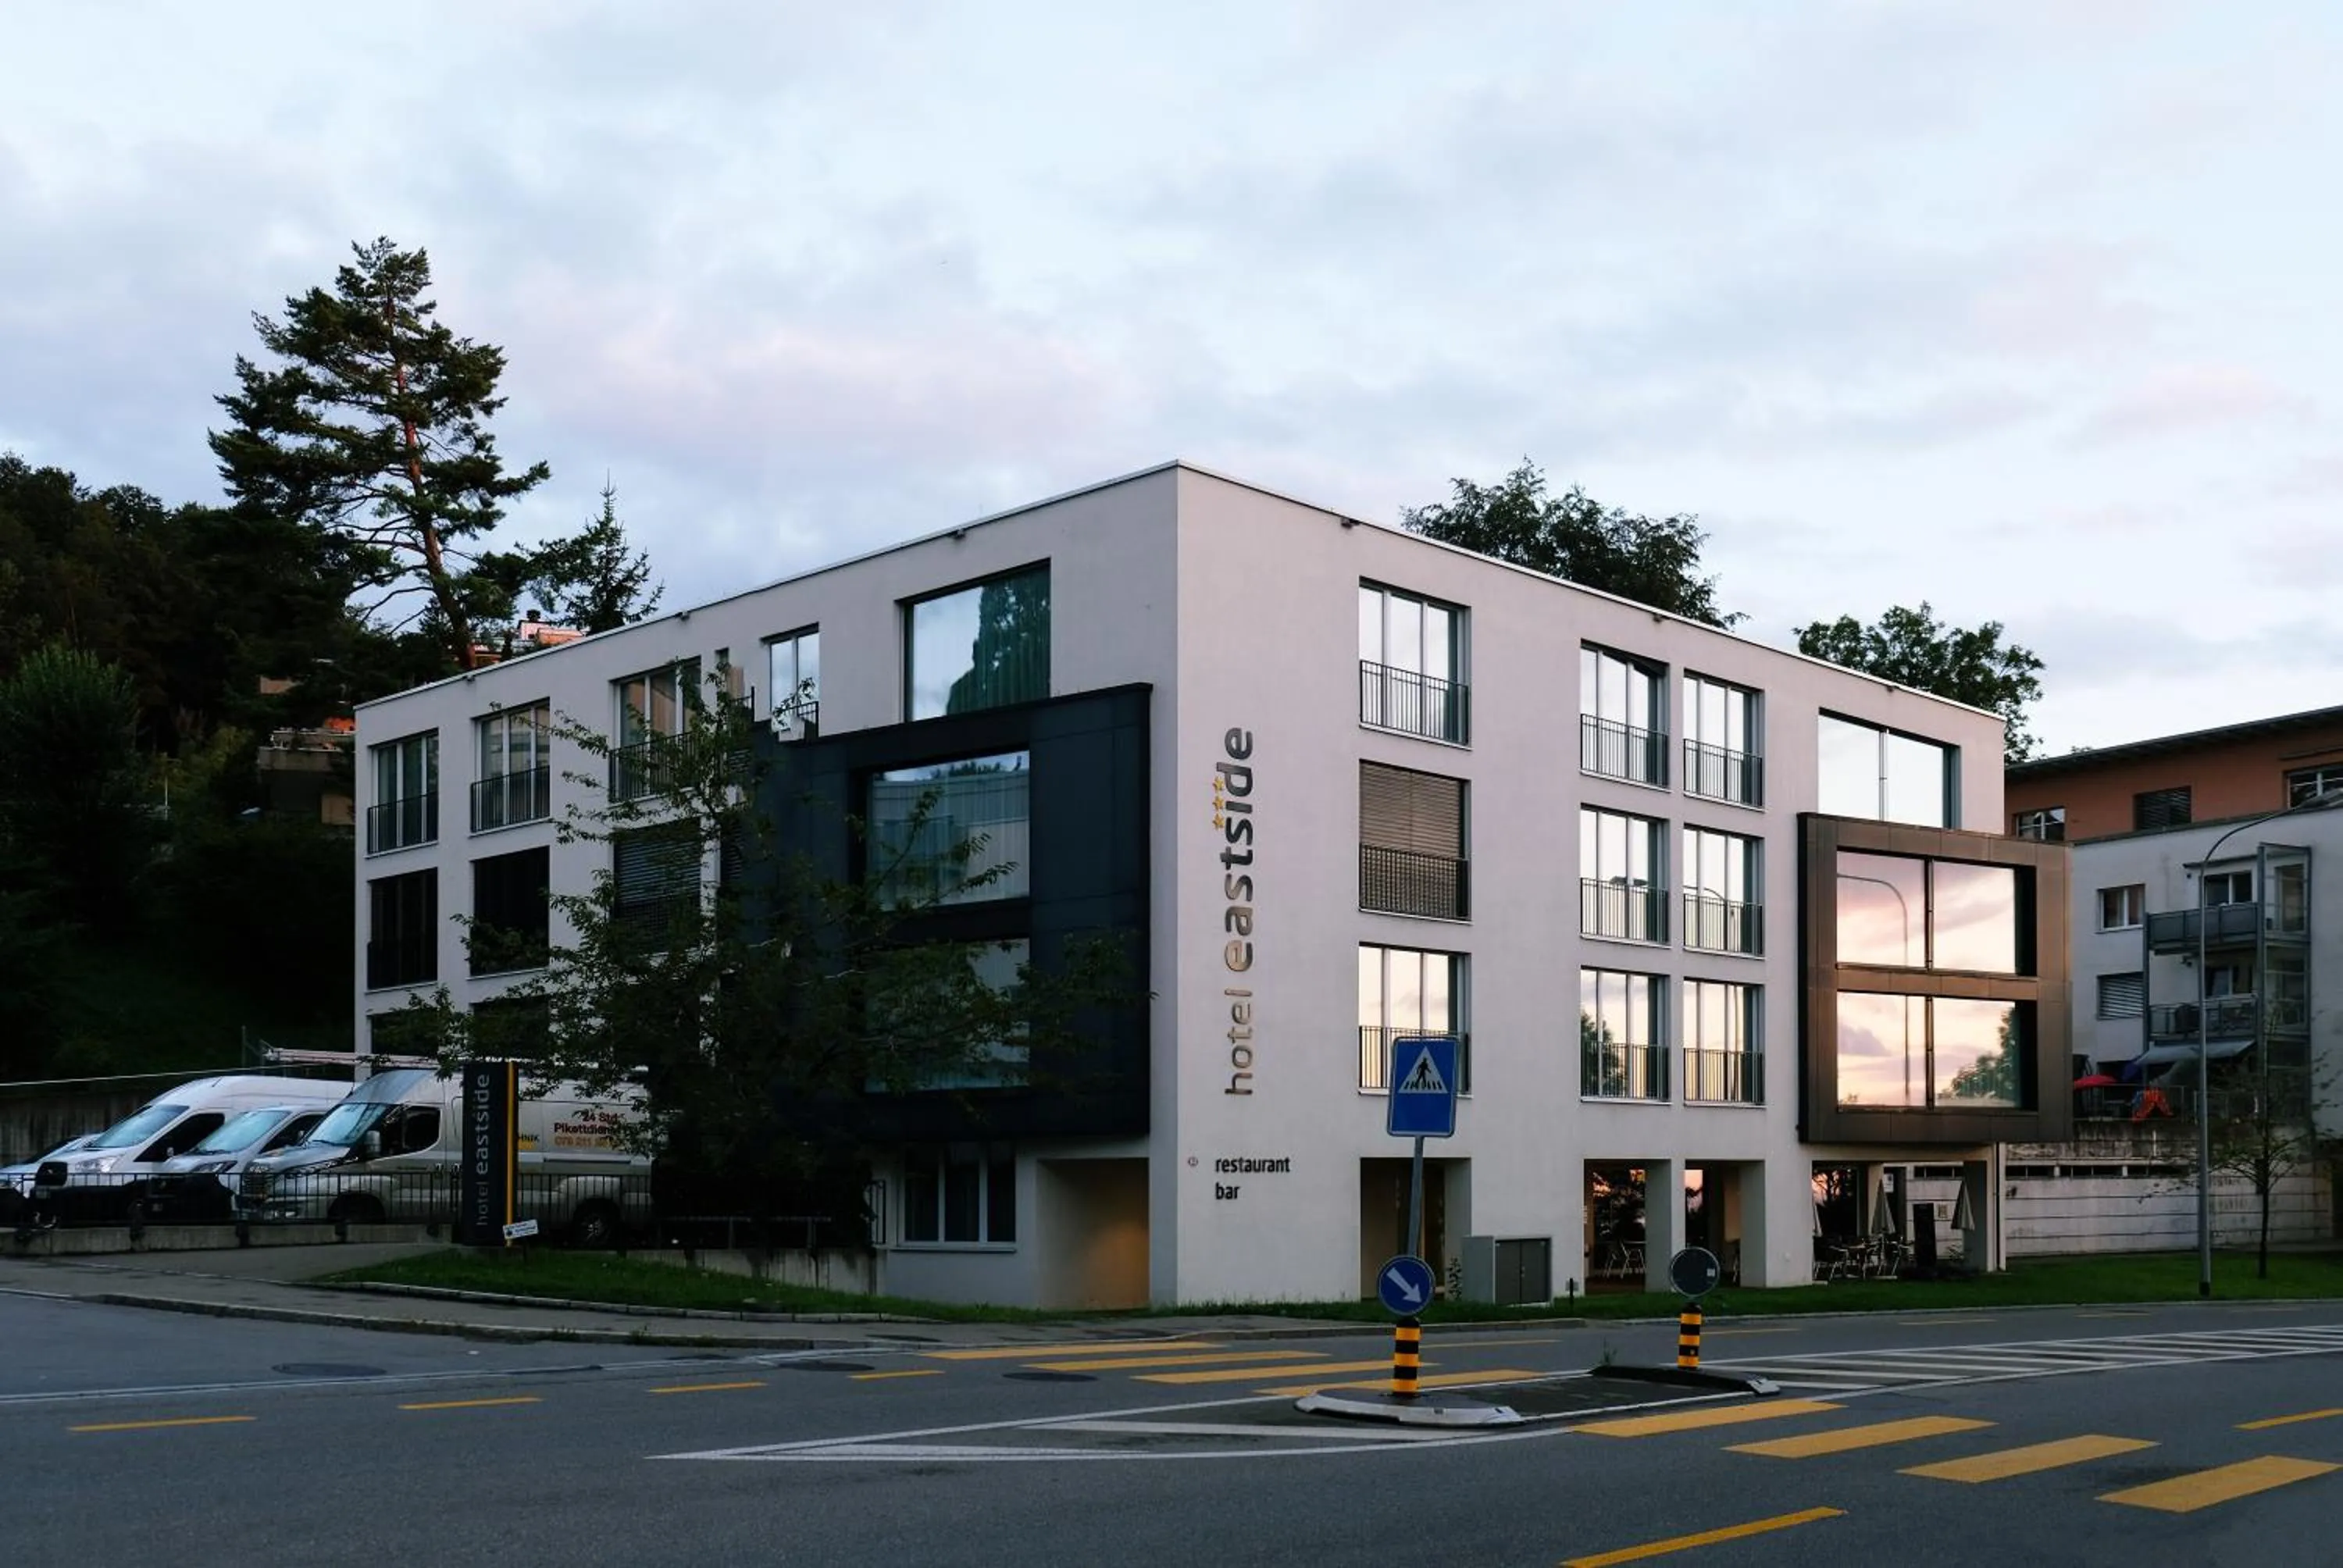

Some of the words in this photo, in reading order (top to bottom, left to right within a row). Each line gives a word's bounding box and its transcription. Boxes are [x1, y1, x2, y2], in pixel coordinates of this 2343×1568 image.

[1216, 727, 1253, 971] eastside
[1224, 988, 1253, 1095] hotel
[475, 1074, 490, 1174] eastside
[1215, 1157, 1290, 1173] restaurant
[1215, 1181, 1239, 1200] bar
[476, 1181, 489, 1226] hotel
